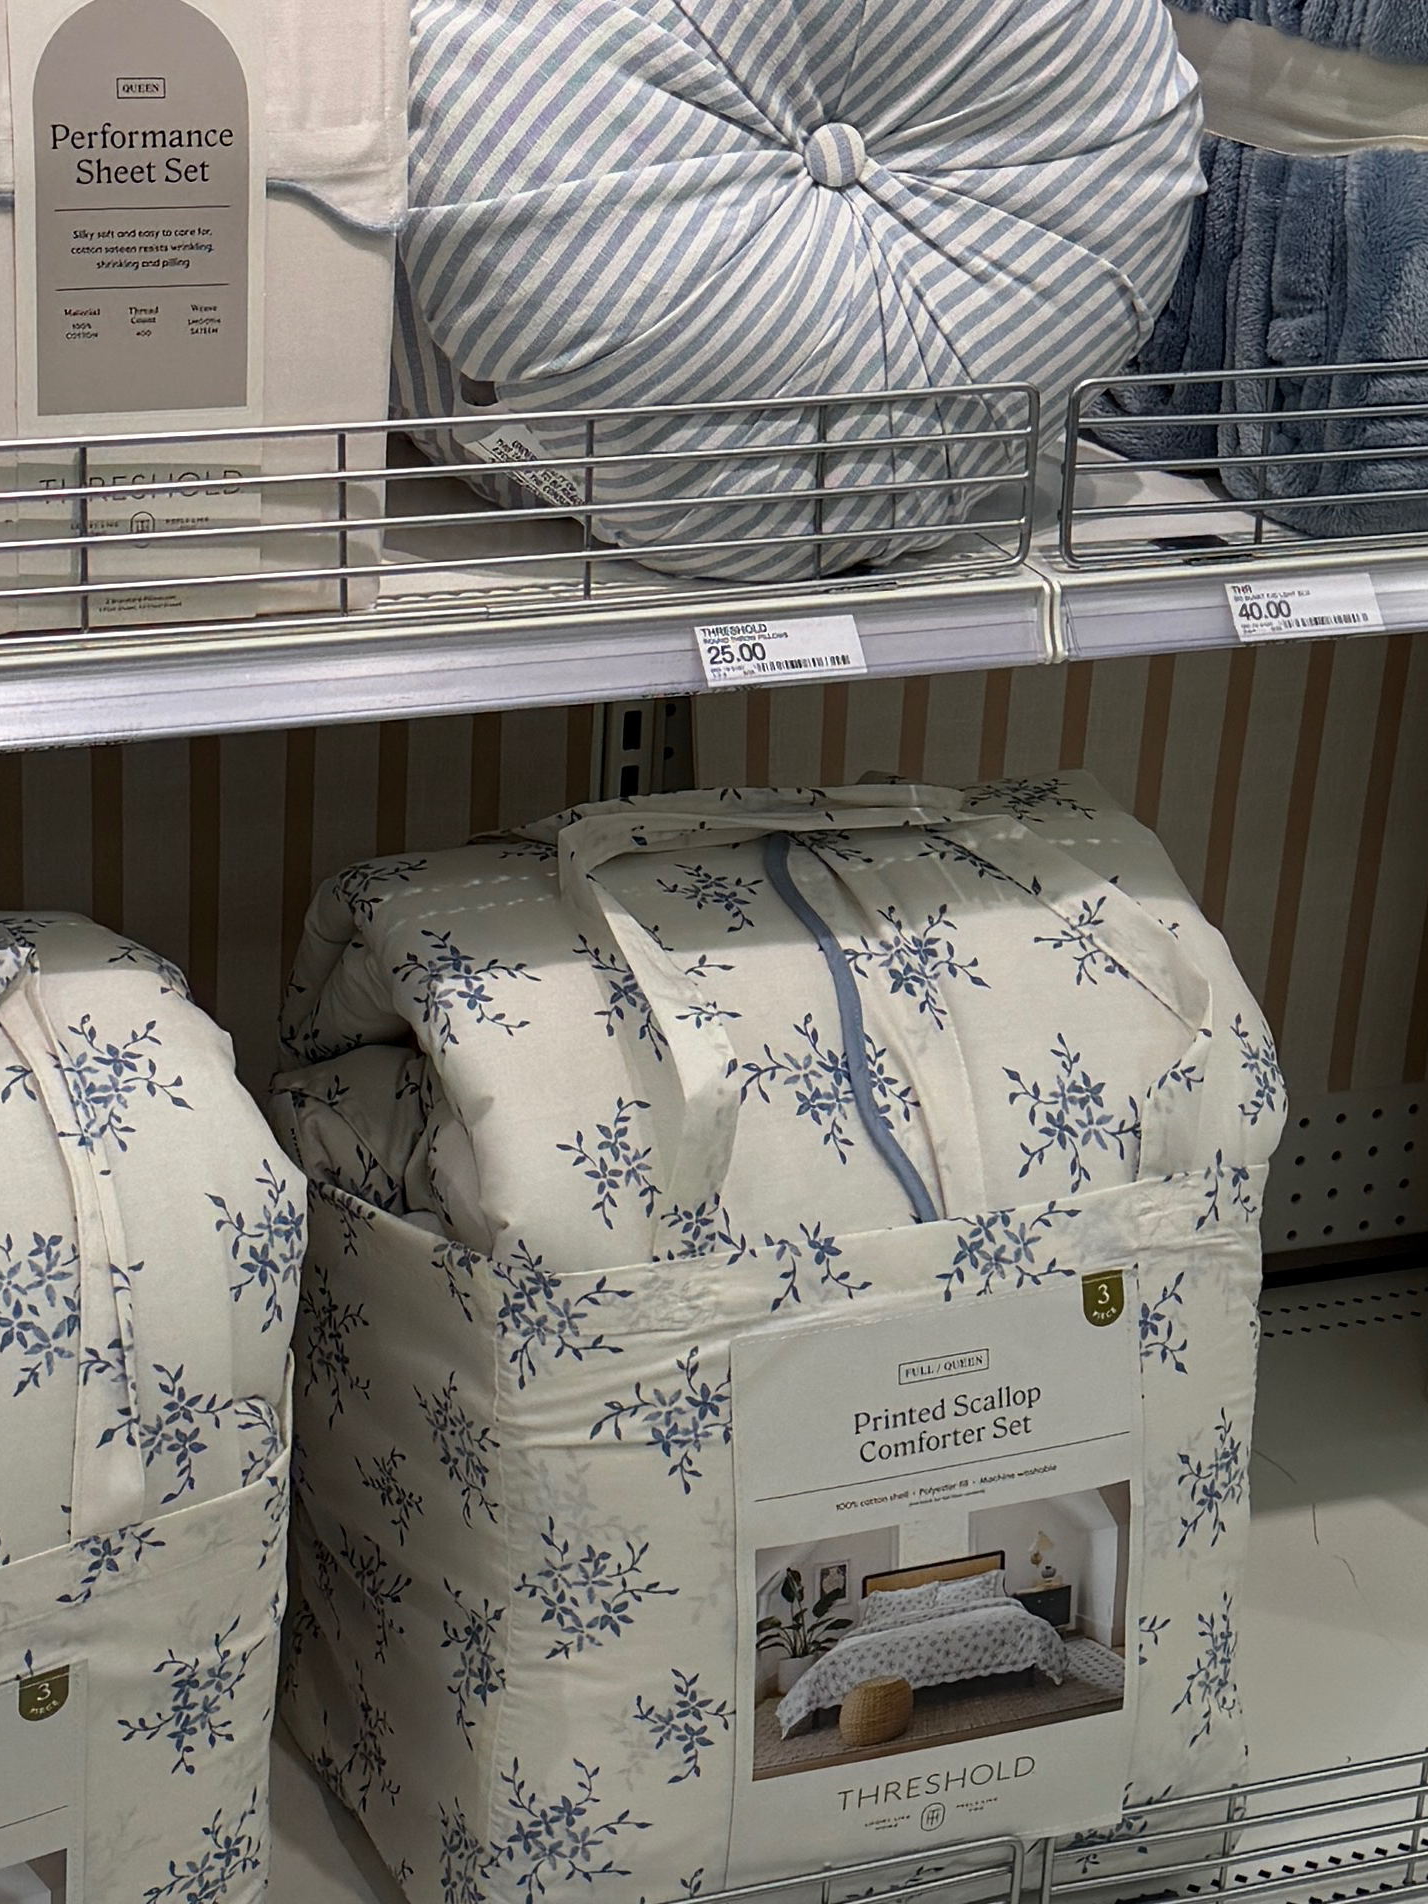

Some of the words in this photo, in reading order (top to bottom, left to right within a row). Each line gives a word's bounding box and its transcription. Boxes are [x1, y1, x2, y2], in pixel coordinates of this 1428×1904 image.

[122, 83, 160, 93] QUEEN
[50, 122, 234, 150] Performance
[76, 158, 157, 185] Sheet
[165, 158, 210, 183] Set
[1239, 600, 1291, 621] 40.00
[701, 624, 767, 638] THRESHOLD
[707, 643, 766, 665] 25.00
[1098, 1283, 1110, 1304] 3
[905, 1365, 934, 1379] FULL
[943, 1355, 983, 1372] QUEEN
[854, 1399, 946, 1434] Printed
[954, 1385, 1041, 1418] Scallop
[859, 1426, 986, 1463] Comforter
[993, 1416, 1032, 1440] Set
[36, 1682, 52, 1701] 3
[838, 1756, 1036, 1811] THRESHOLD
